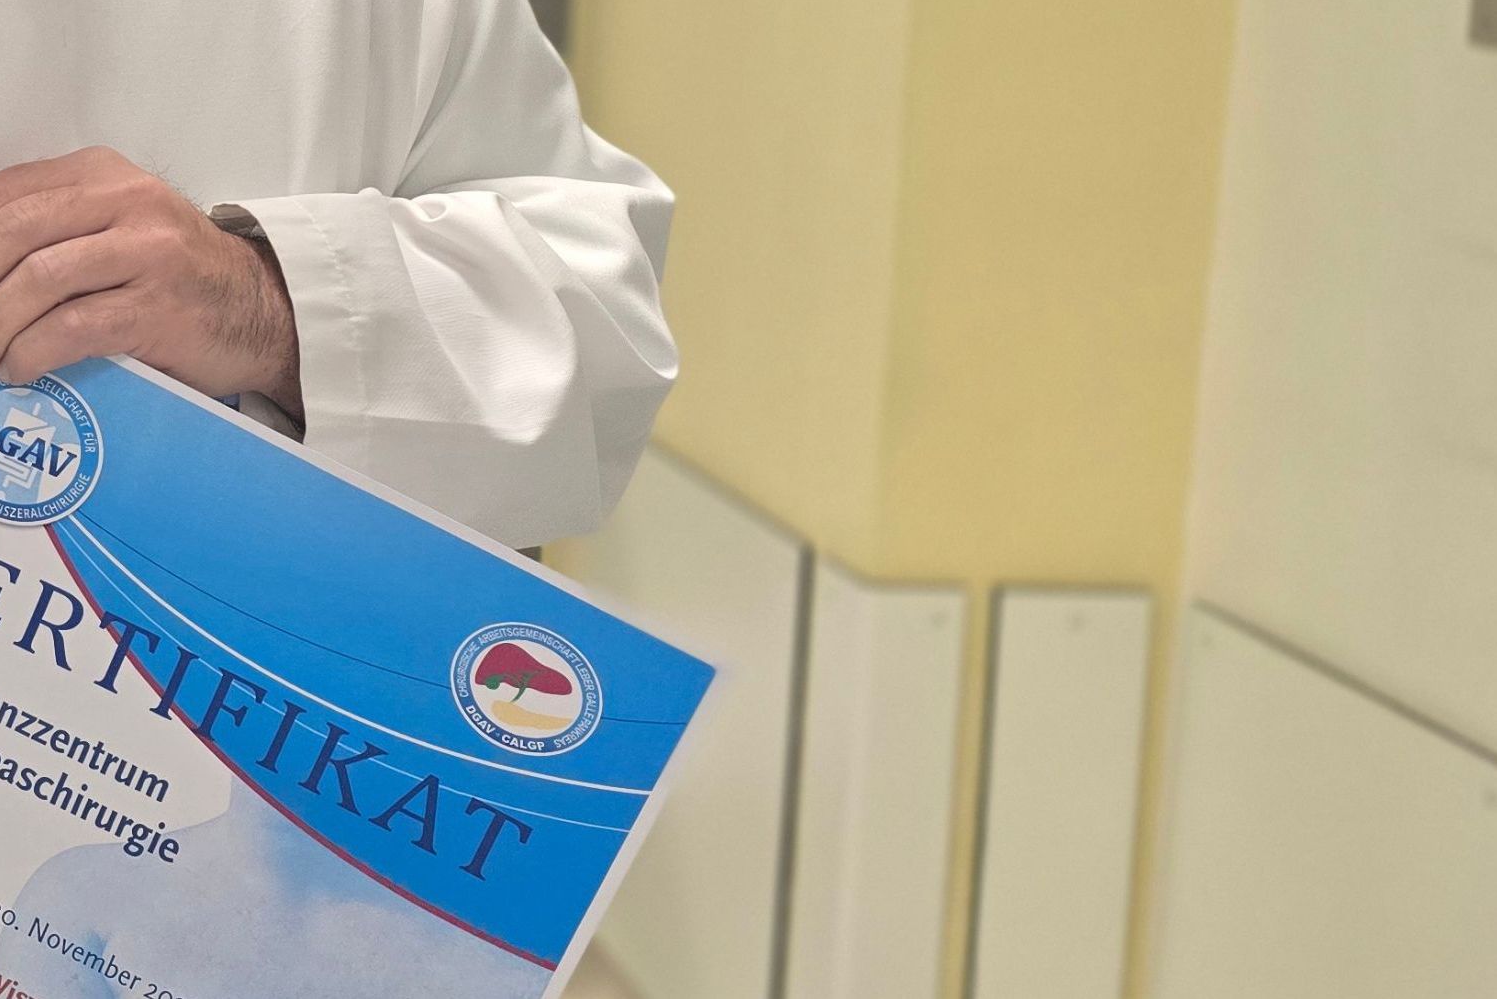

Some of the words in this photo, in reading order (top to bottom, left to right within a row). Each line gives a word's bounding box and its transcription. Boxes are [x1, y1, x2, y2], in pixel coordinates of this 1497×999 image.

[82, 432, 96, 453] FÜR
[466, 705, 496, 734] DGAV
[28, 917, 141, 989] November
